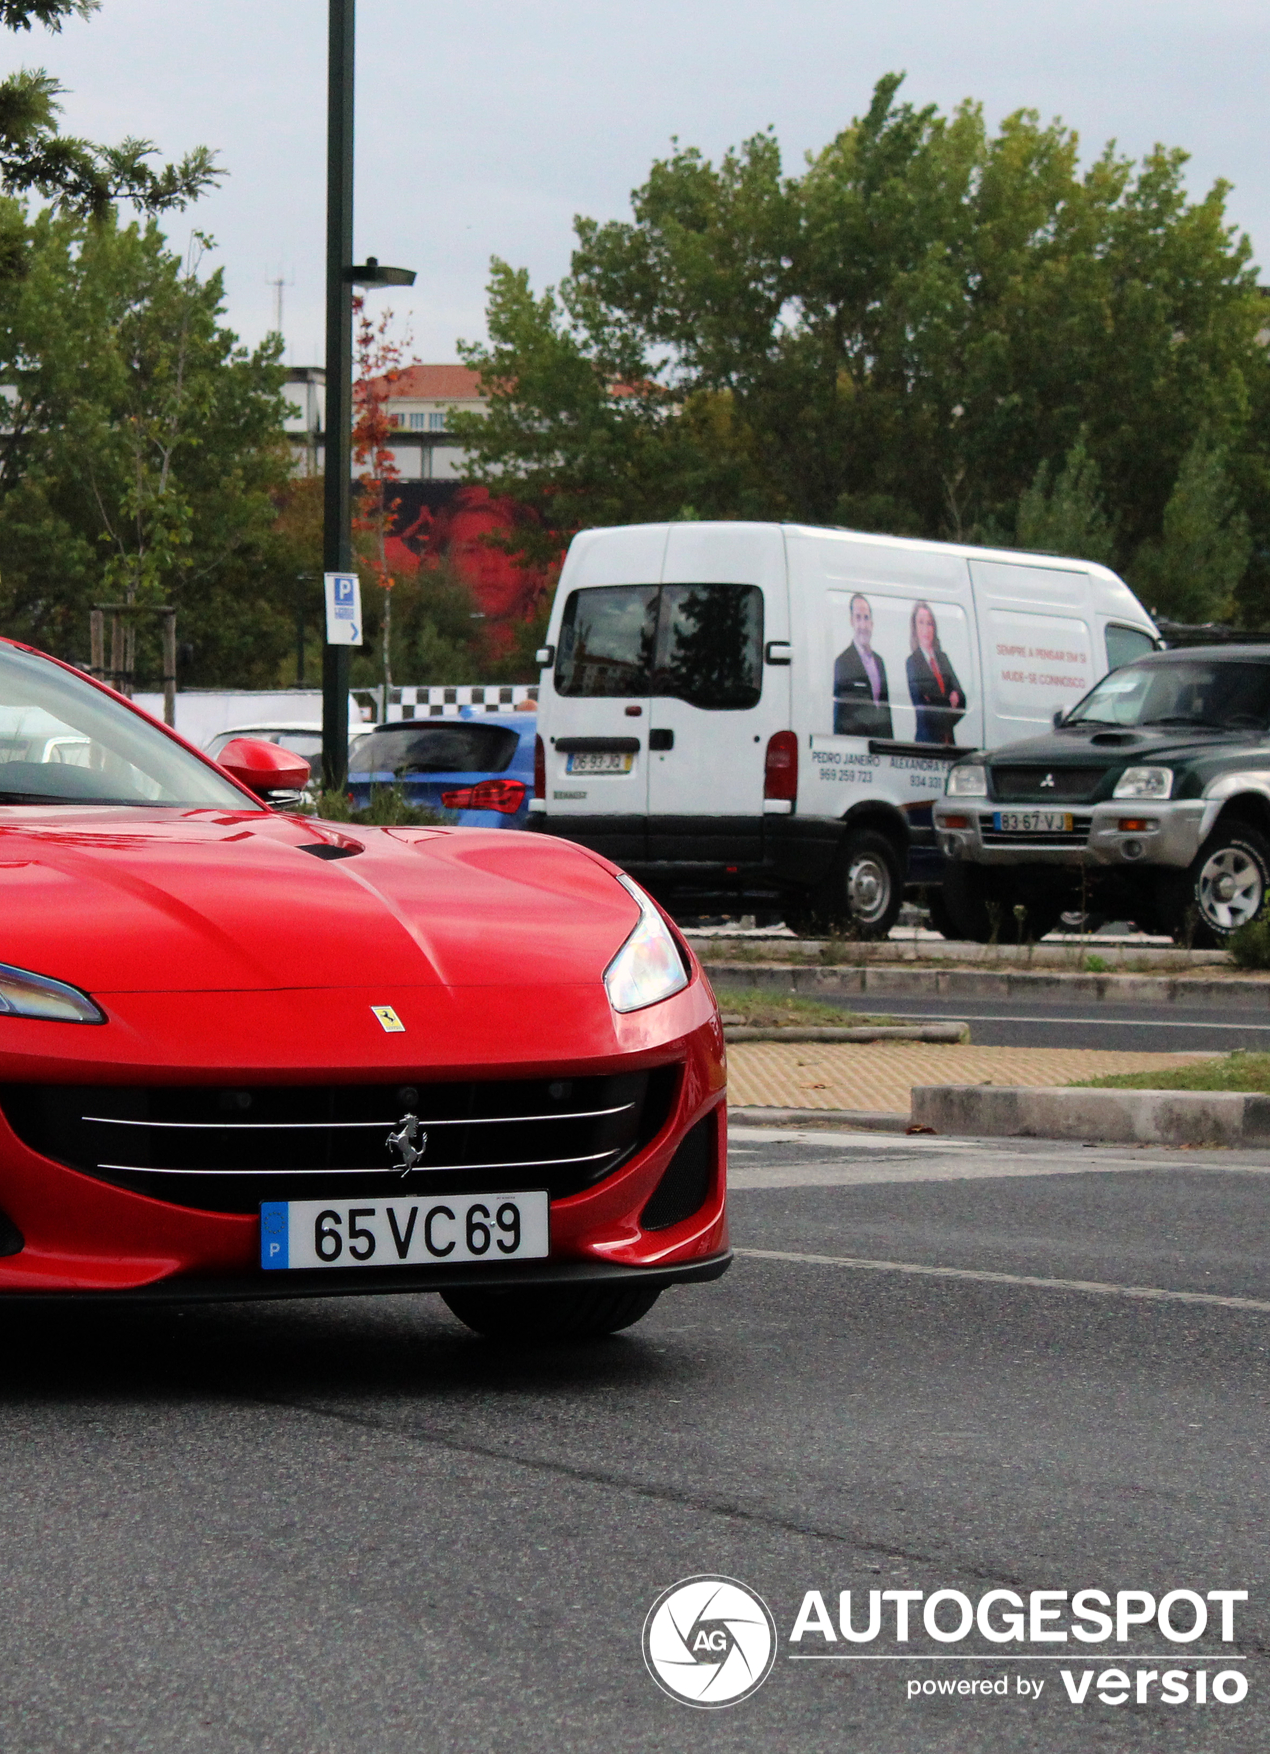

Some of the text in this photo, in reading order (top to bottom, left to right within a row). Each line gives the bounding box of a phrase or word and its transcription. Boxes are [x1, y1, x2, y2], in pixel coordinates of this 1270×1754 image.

[340, 580, 351, 600] P
[812, 752, 881, 767] PEDRO JANEIRO
[890, 757, 940, 771] ALEXANDRA
[270, 1242, 280, 1257] P
